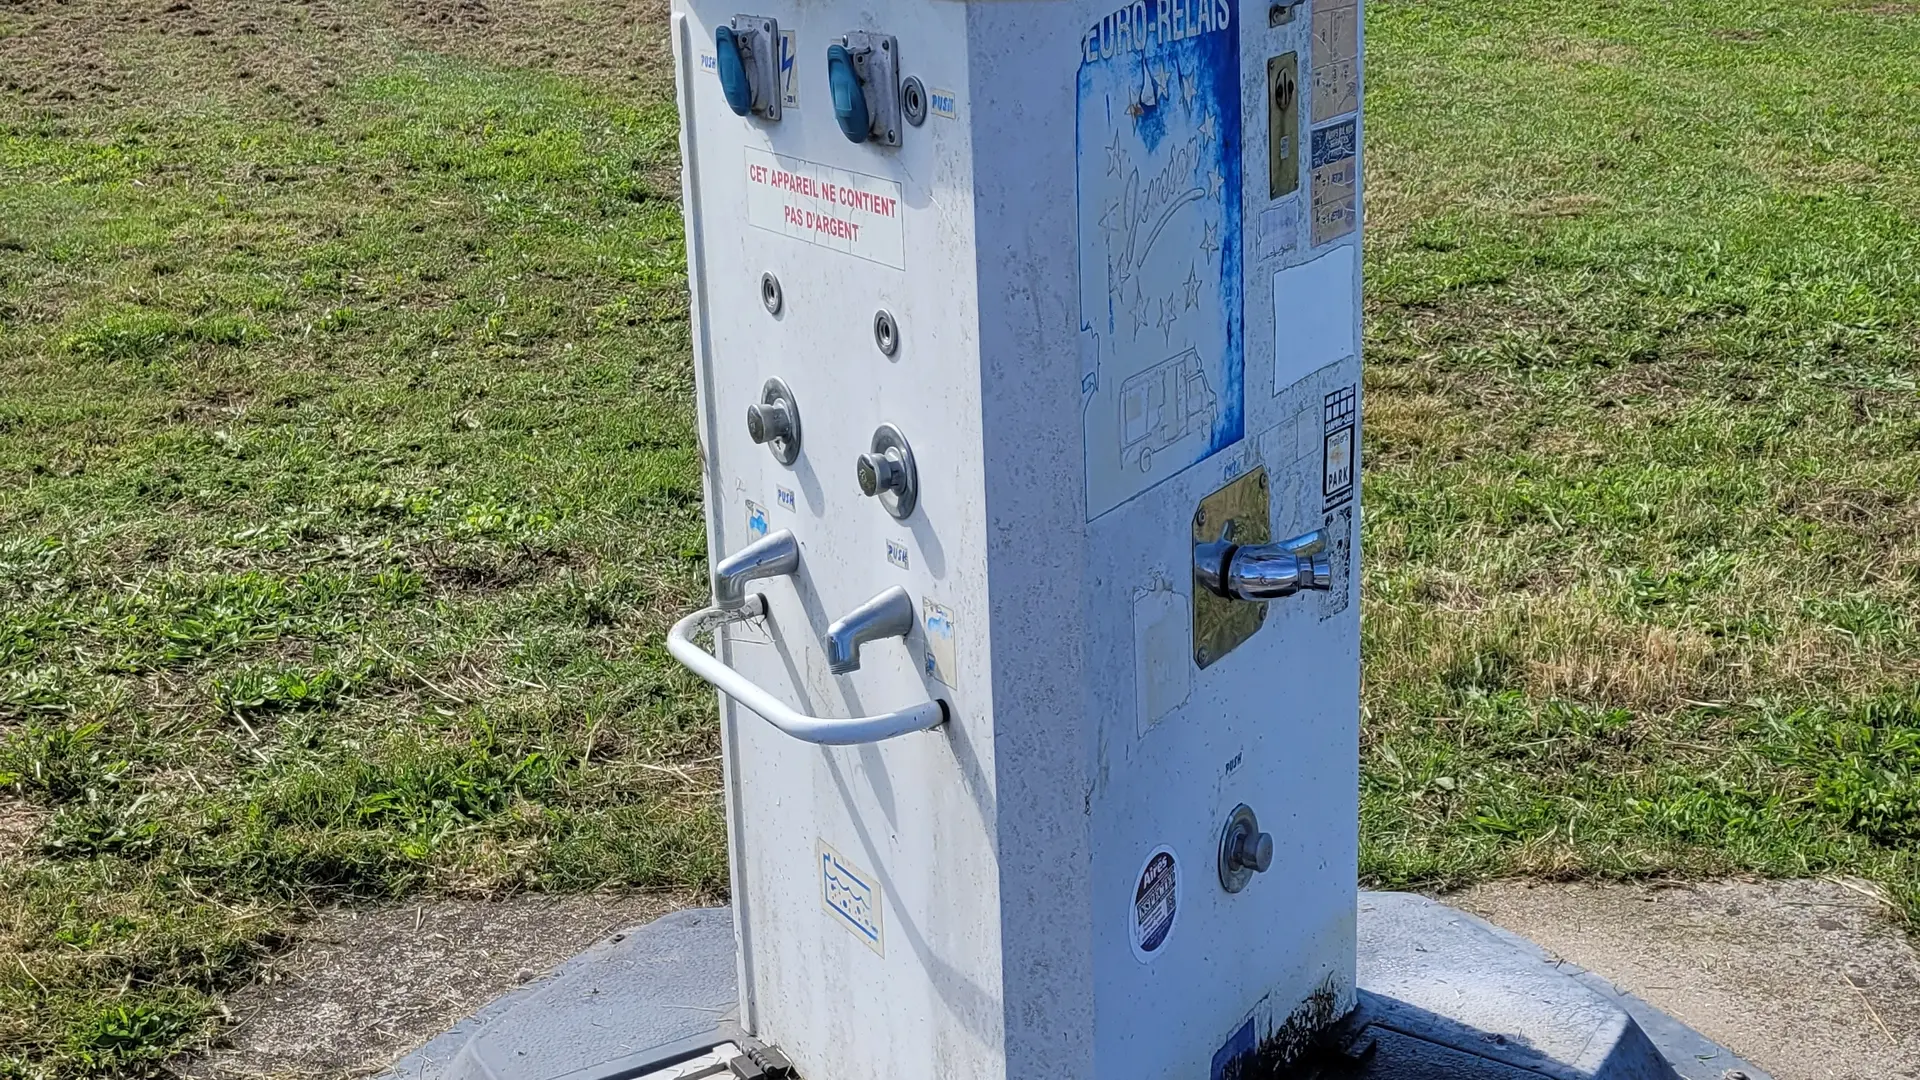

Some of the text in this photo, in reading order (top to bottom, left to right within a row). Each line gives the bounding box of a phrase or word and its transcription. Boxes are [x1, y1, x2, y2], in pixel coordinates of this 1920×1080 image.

[1085, 0, 1230, 63] EURO-RELAIS
[701, 54, 716, 69] PUSH
[931, 94, 954, 113] PUSH
[750, 164, 896, 218] CET APPAREIL NE CONTIENT
[784, 205, 859, 242] PAS D'ARGENT
[1328, 465, 1348, 490] PARK
[777, 488, 795, 505] PUSH
[888, 545, 908, 564] PUSH
[1225, 752, 1243, 776] PUSH
[1143, 856, 1168, 889] Aires
